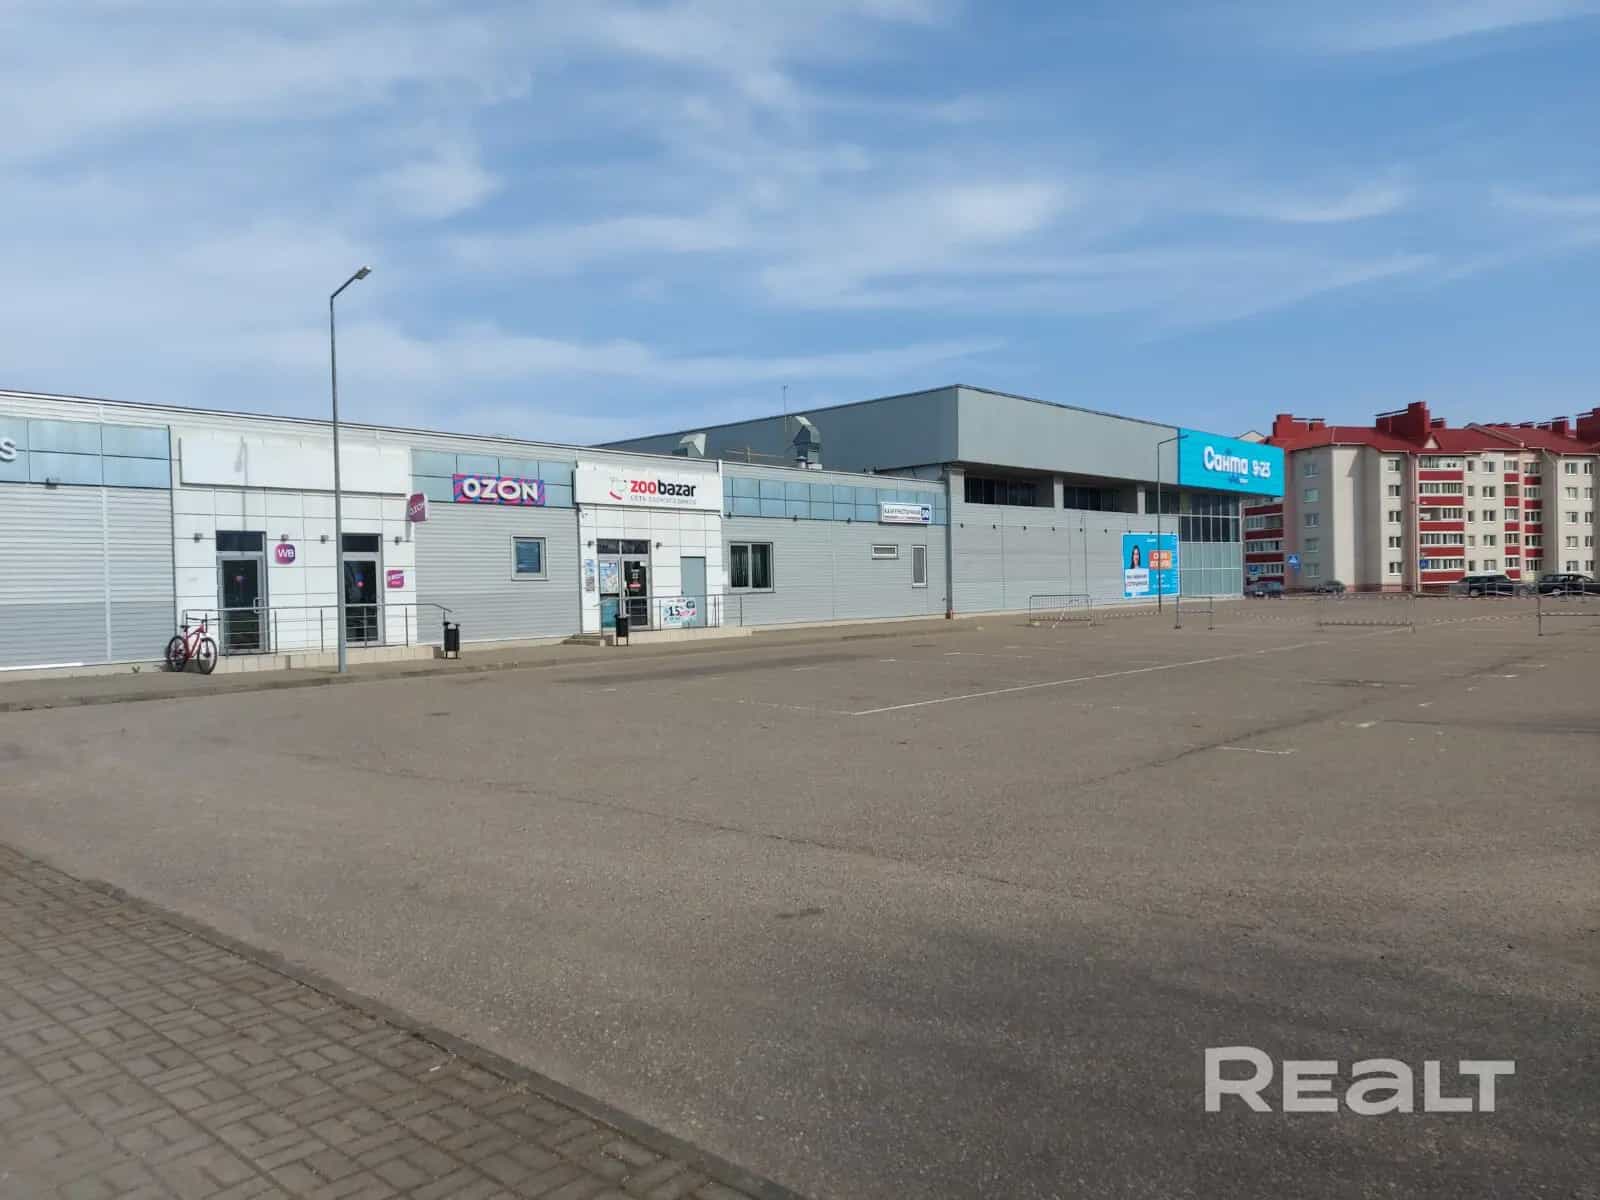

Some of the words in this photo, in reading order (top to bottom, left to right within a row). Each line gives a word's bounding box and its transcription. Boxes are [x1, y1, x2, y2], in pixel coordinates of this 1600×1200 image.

[1203, 445, 1249, 475] Санта
[462, 478, 539, 502] OZON
[630, 480, 697, 497] zoobazar
[278, 548, 294, 557] WB
